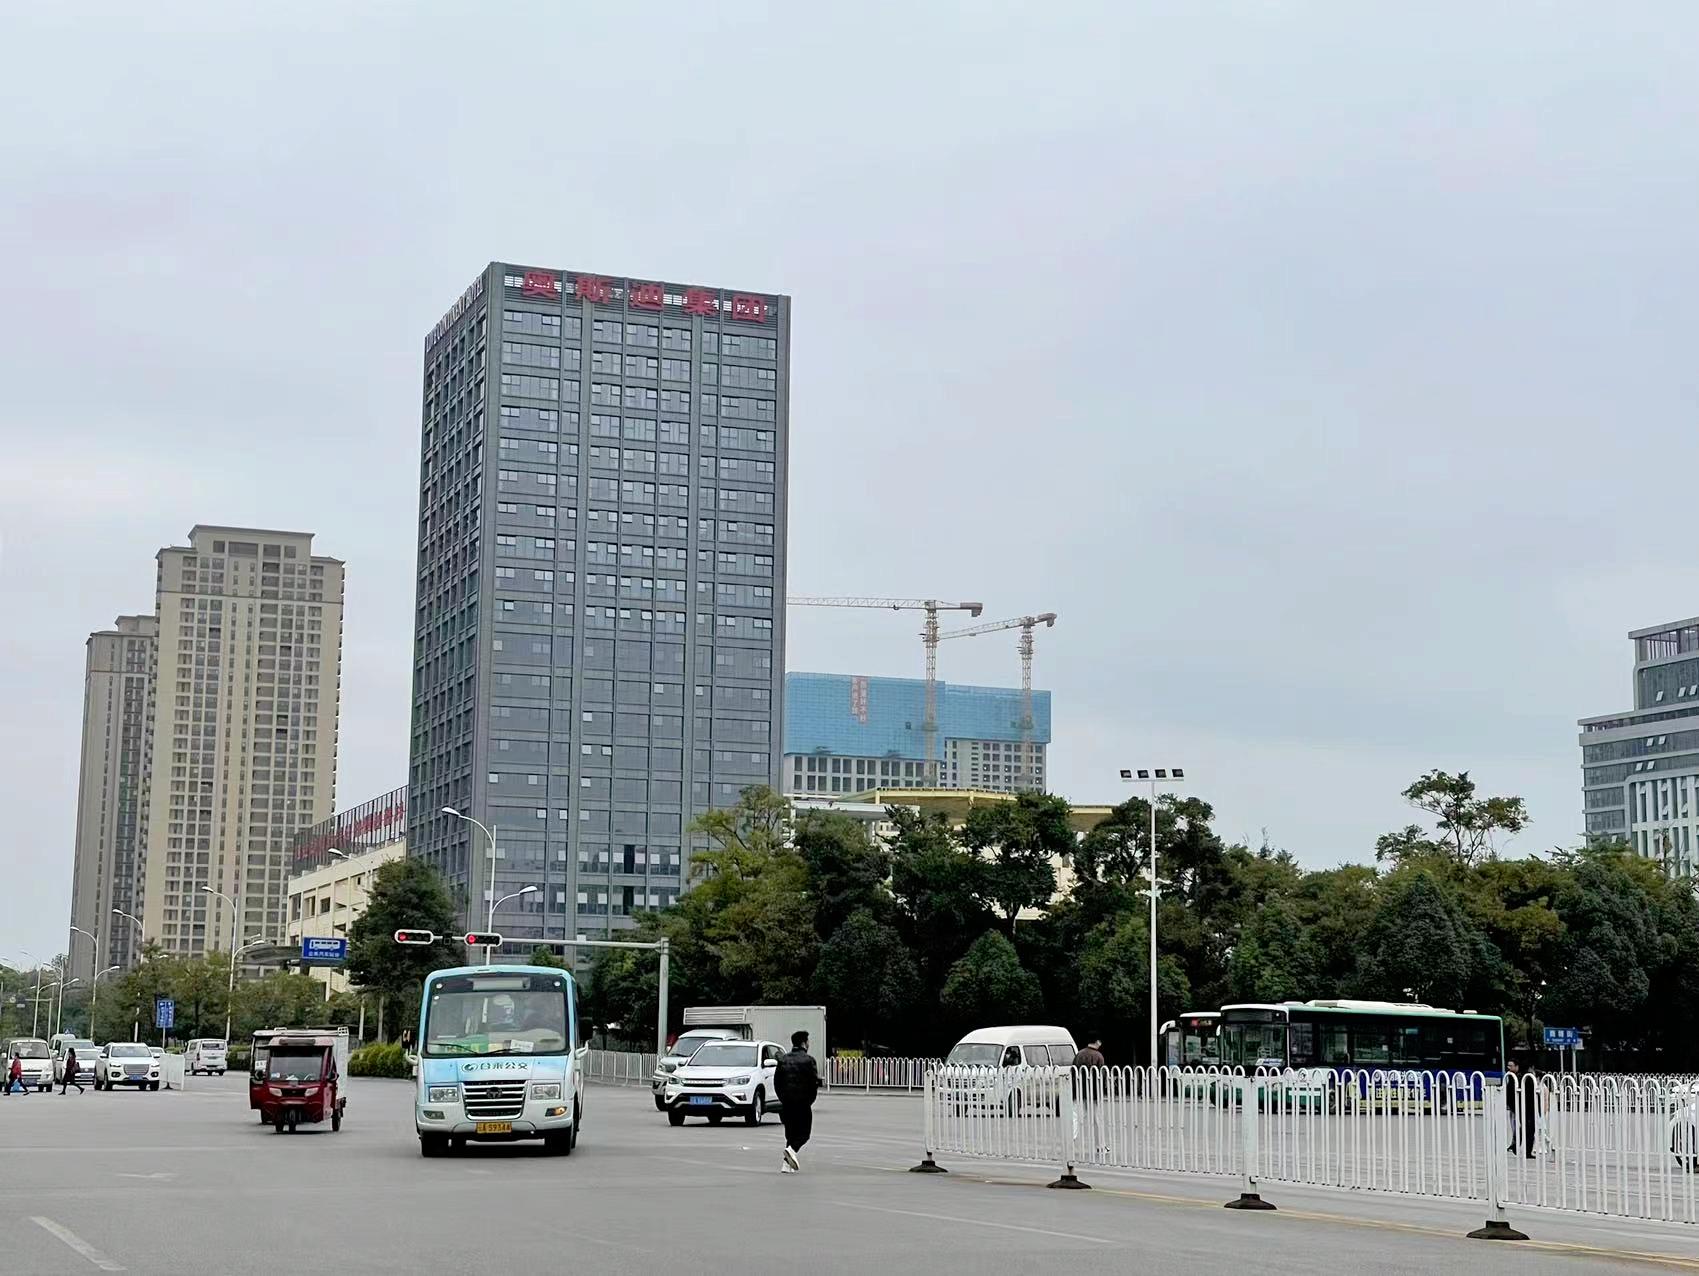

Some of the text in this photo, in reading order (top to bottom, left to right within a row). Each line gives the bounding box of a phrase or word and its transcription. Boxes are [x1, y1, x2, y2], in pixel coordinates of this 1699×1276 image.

[522, 270, 767, 323] 奥斯迪集团
